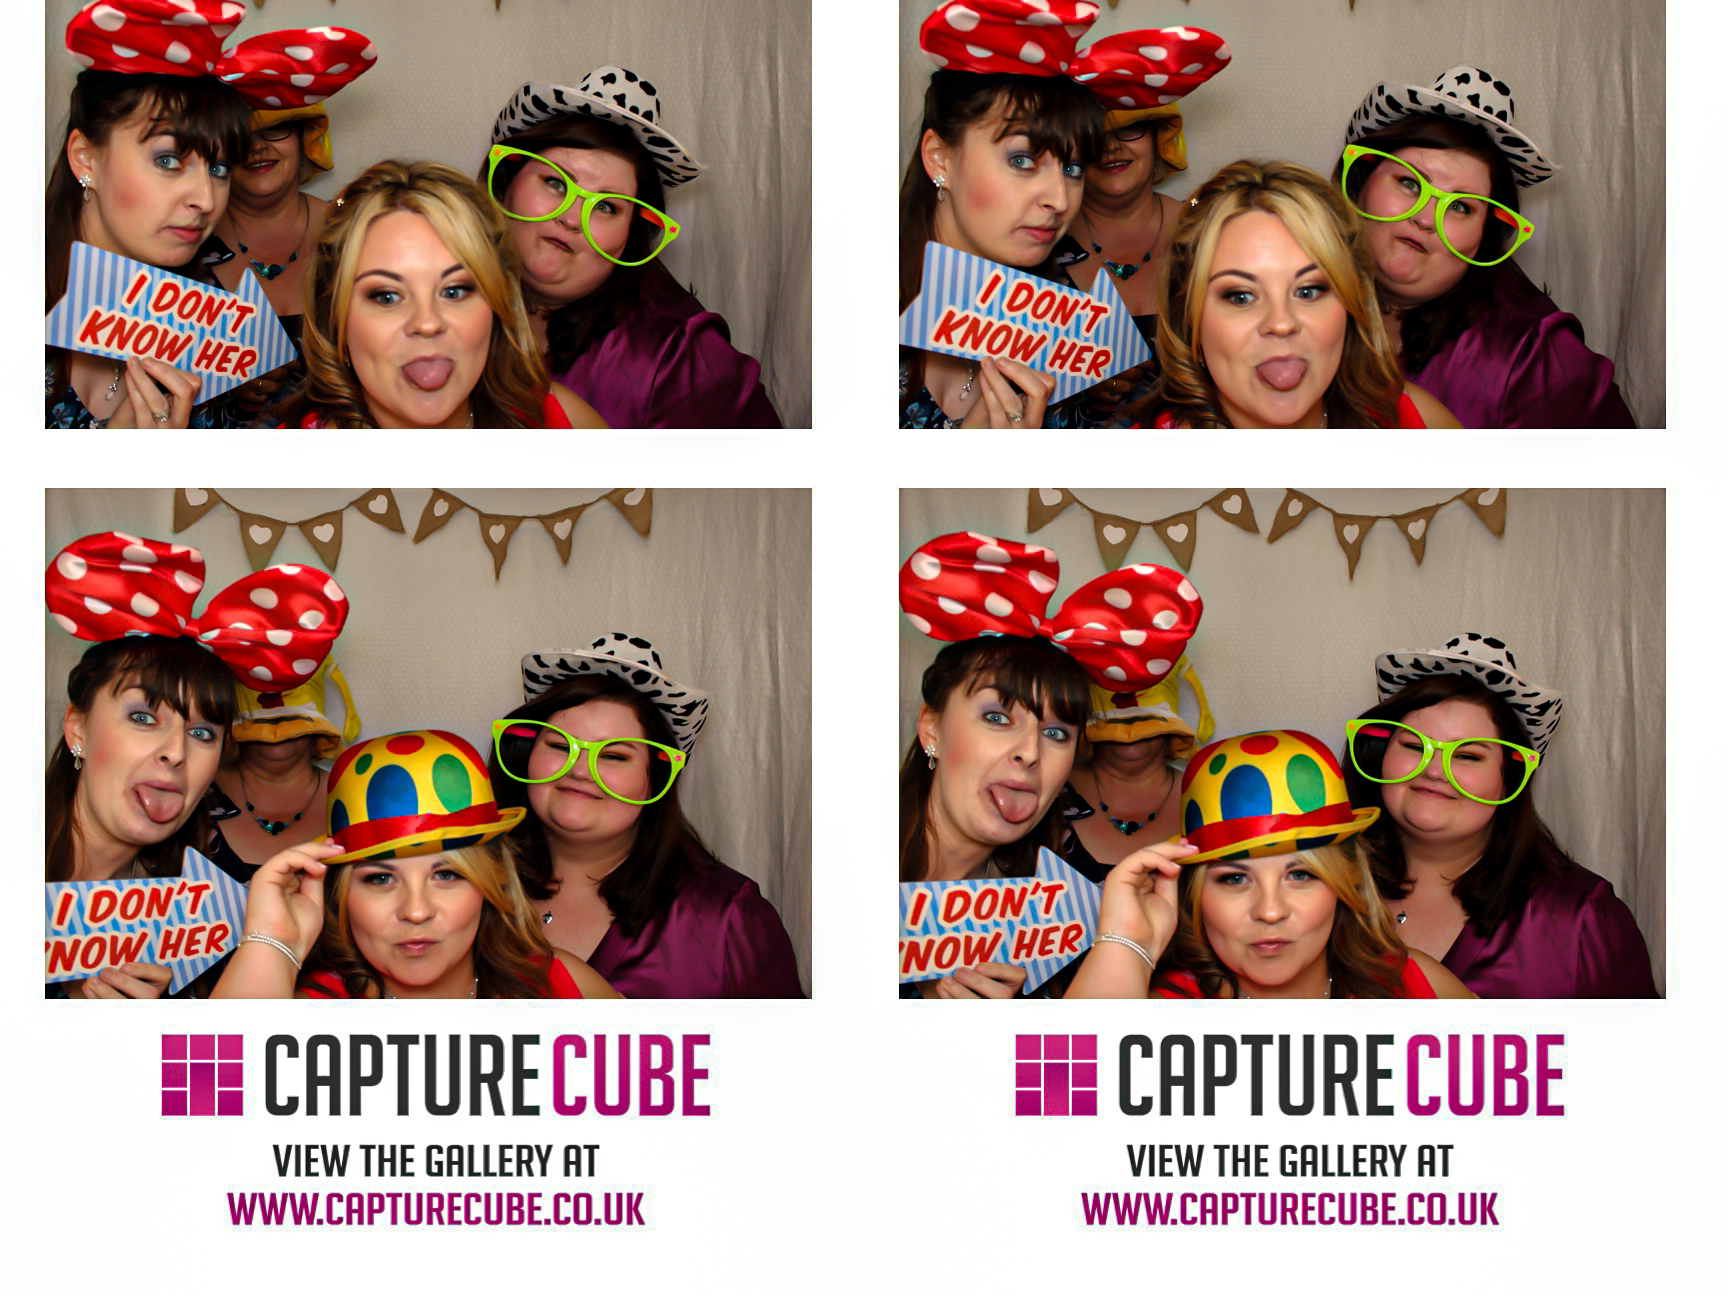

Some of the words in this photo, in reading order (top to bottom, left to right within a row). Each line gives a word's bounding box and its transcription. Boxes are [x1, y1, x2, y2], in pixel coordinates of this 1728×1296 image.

[126, 273, 148, 305] I
[152, 282, 254, 334] DON'T
[980, 273, 1002, 305] I
[1006, 282, 1108, 334] DON'T
[79, 309, 193, 363] KNOW
[194, 339, 256, 378] HER
[933, 309, 1047, 363] KNOW
[1048, 339, 1110, 378] HER
[56, 892, 73, 926] I
[88, 881, 210, 923] DON'T
[910, 892, 927, 926] I
[942, 881, 1064, 923] DON'T
[45, 931, 148, 974] NOW
[159, 923, 229, 960] HER
[899, 931, 1002, 974] NOW
[1013, 923, 1083, 960] HER
